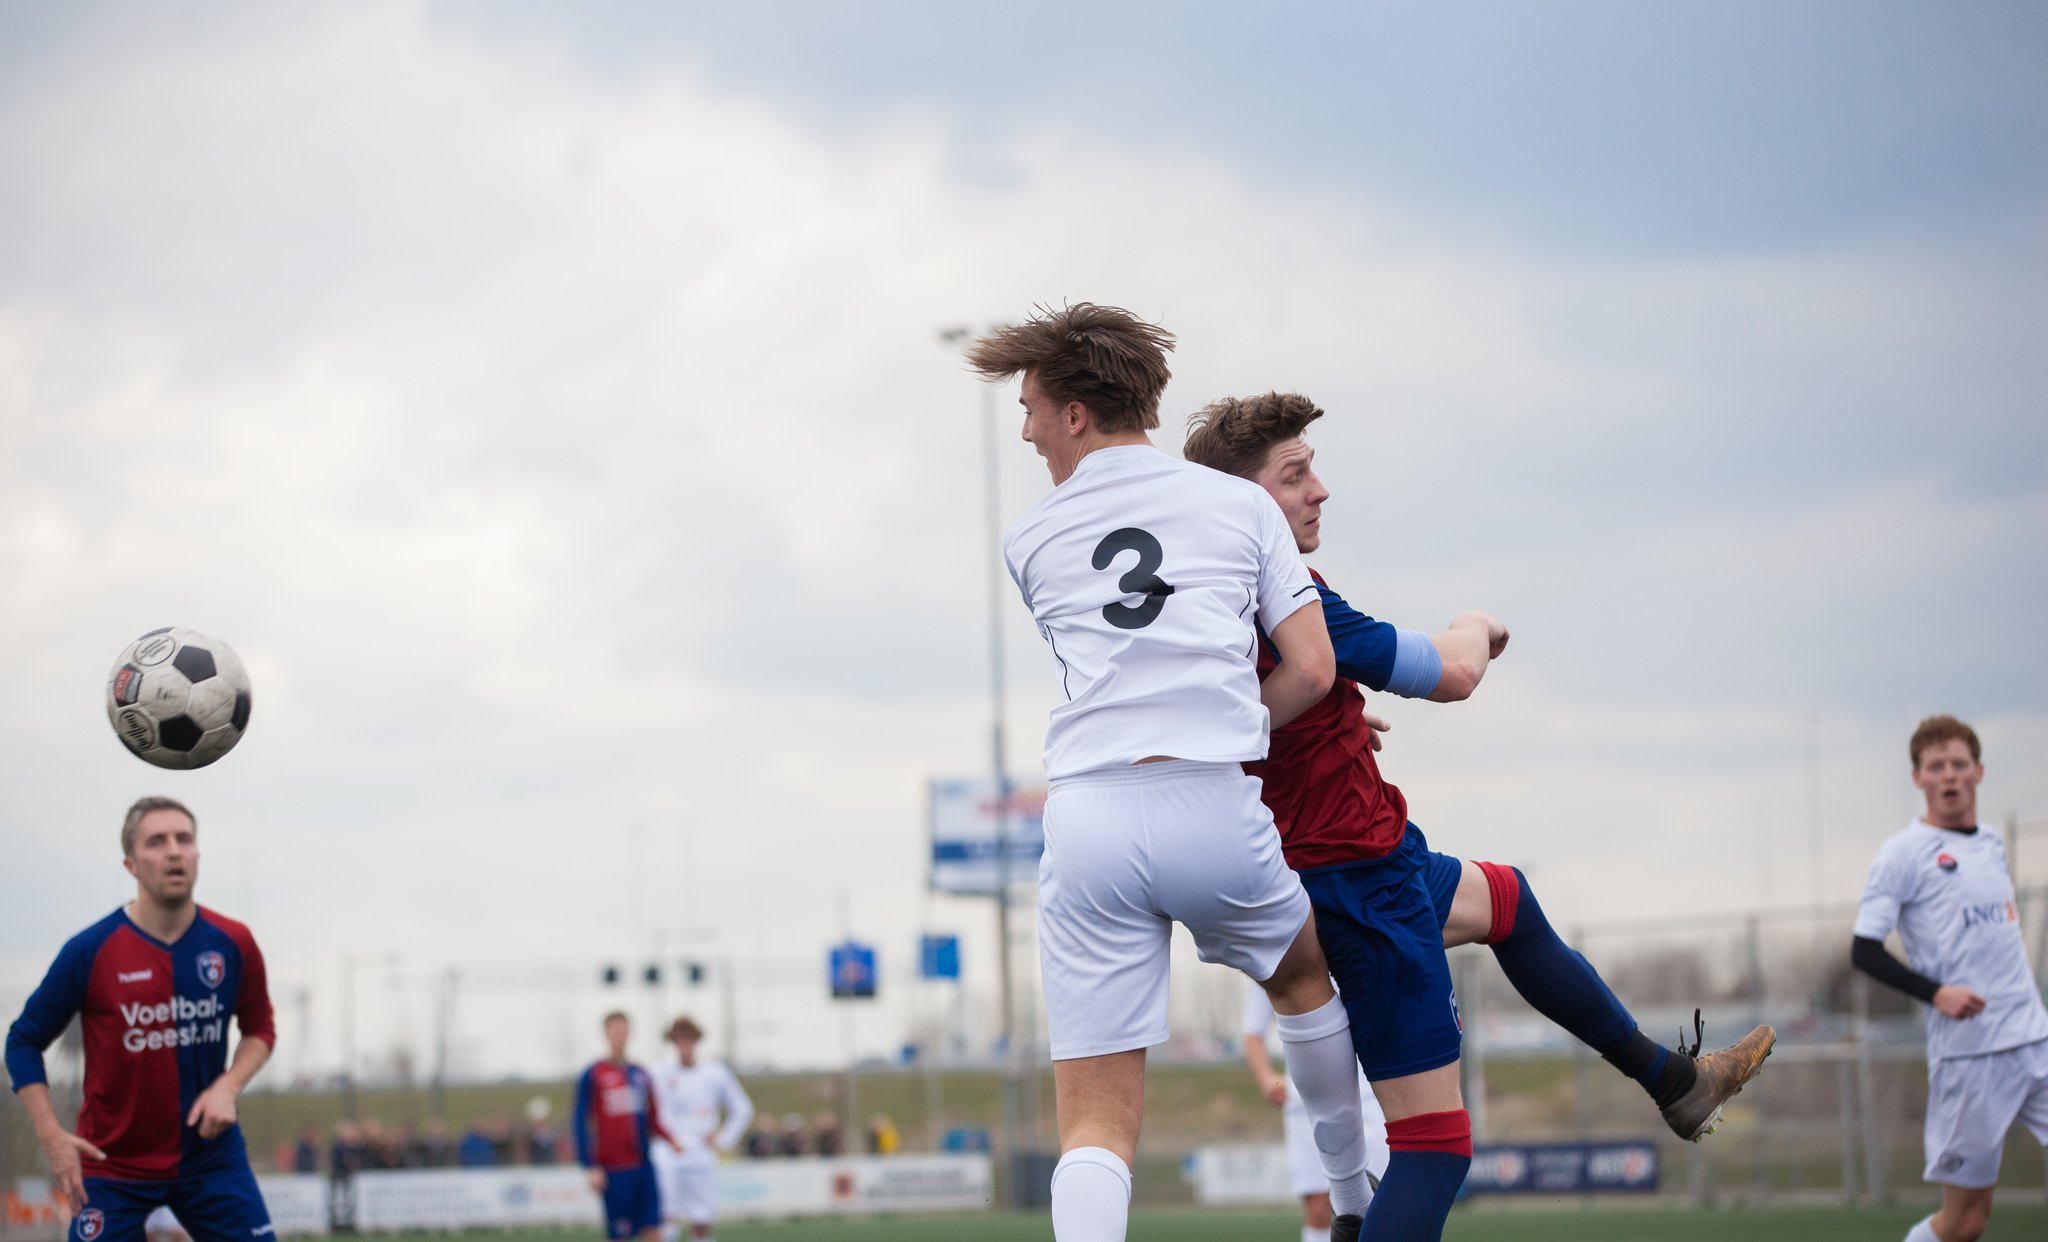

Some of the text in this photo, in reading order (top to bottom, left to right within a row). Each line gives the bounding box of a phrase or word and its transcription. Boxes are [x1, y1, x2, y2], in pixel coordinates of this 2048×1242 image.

[1091, 527, 1175, 630] 3
[1963, 902, 2005, 928] ING
[119, 993, 225, 1027] Voetbal-
[122, 1018, 223, 1053] Geest.nl
